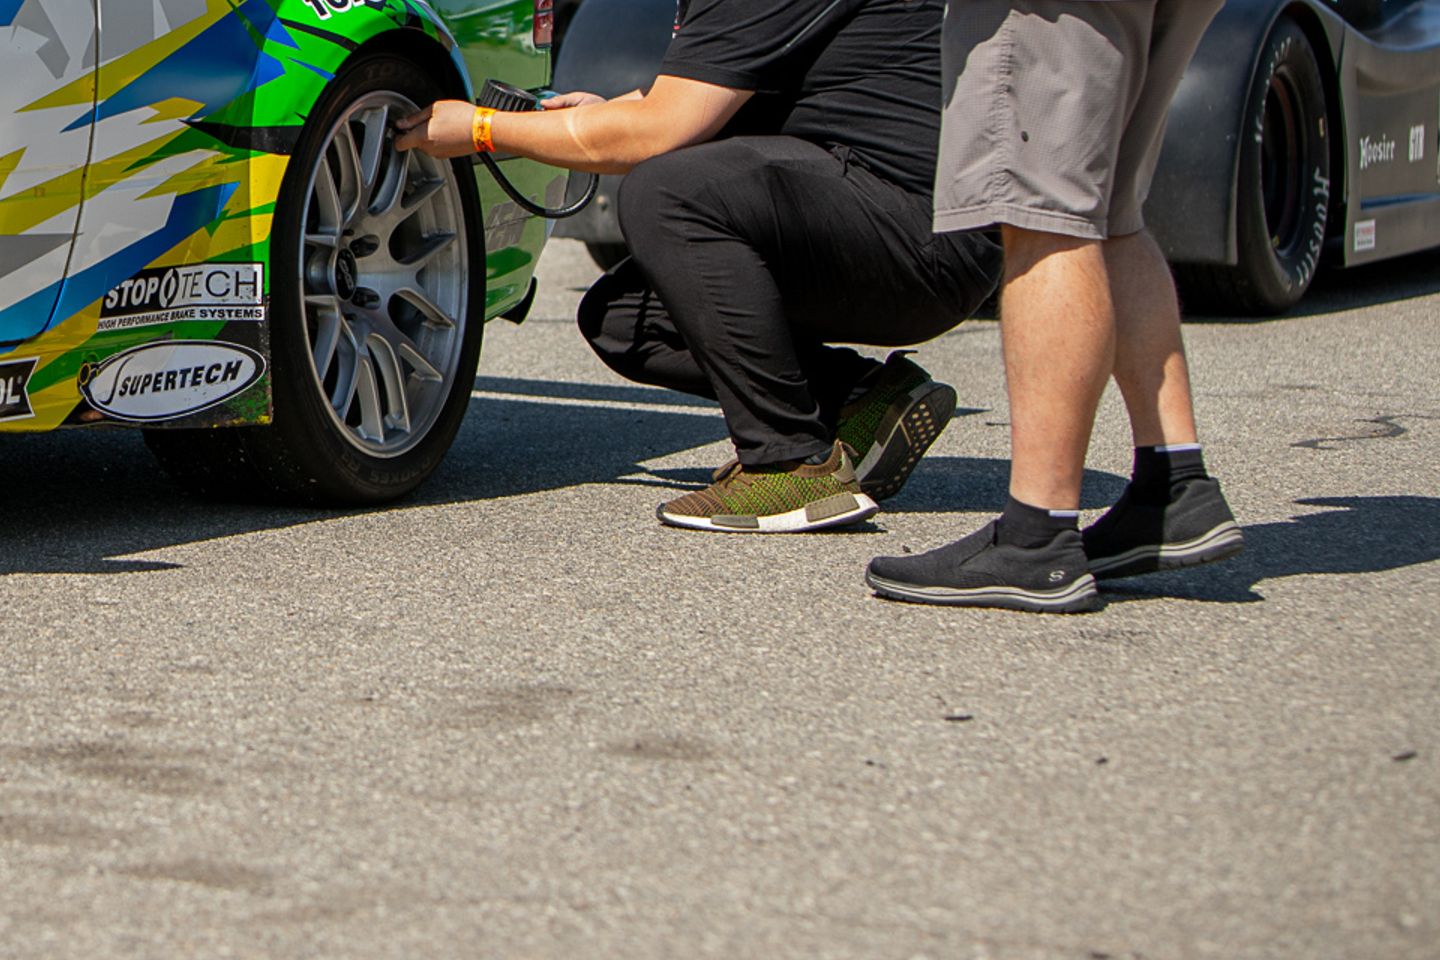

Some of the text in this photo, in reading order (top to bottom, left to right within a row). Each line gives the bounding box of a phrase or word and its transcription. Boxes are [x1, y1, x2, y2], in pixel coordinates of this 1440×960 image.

[98, 308, 263, 330] HIGH PERFORMANCE BRAKE SYSTEMS
[117, 359, 244, 397] SUPERTECH
